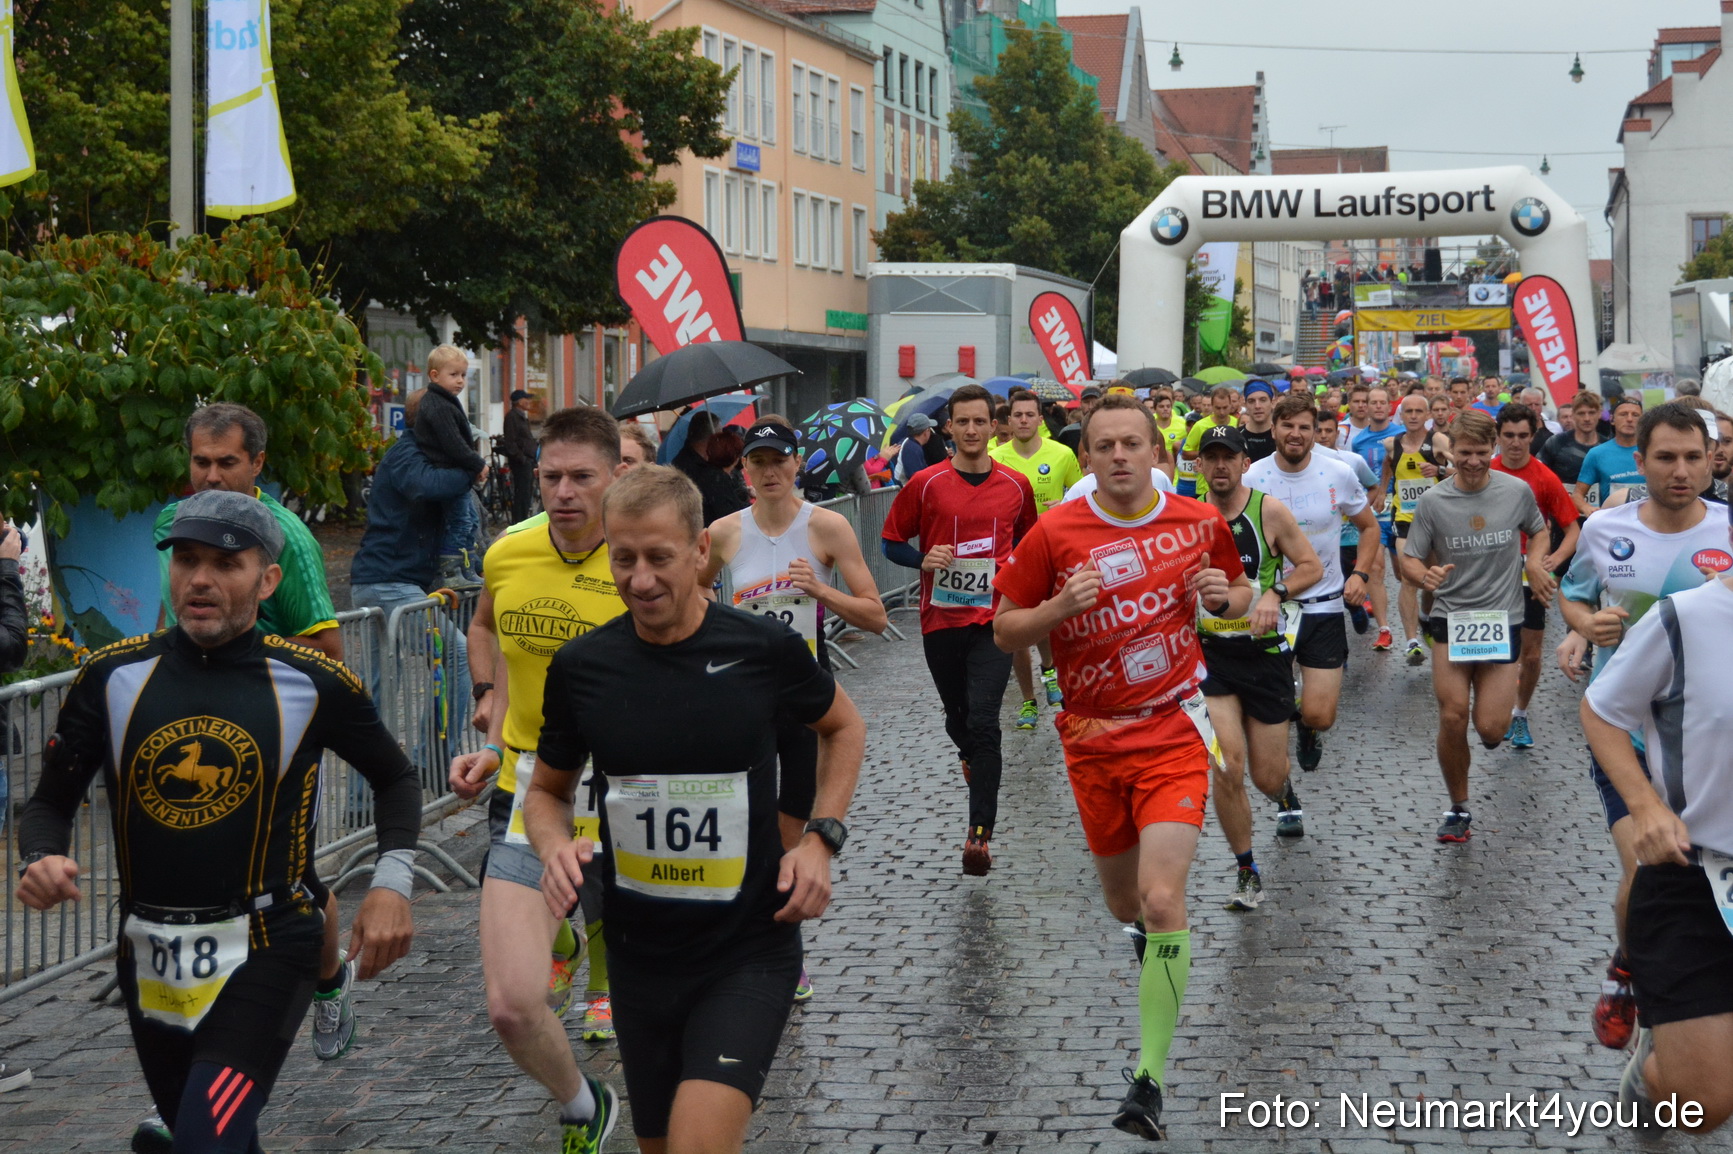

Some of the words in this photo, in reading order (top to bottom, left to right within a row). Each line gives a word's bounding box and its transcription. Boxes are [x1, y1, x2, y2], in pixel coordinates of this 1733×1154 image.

[1202, 188, 1304, 219] BMW
[1314, 184, 1496, 221] Laufsport
[1416, 314, 1450, 327] ZIEL
[1522, 288, 1573, 383] REWE
[393, 411, 403, 426] P
[1445, 529, 1513, 550] LEHMEIER
[1094, 540, 1134, 560] raumbox
[1697, 553, 1729, 567] Hervis
[1152, 552, 1198, 573] schenken
[1608, 564, 1635, 573] PARTL
[938, 568, 989, 593] 2624
[947, 593, 975, 604] Florian
[521, 599, 577, 621] PIZZERIA
[507, 614, 588, 639] FRANCESCO
[1455, 623, 1504, 643] 2228
[1096, 628, 1137, 646] wohnen
[1121, 637, 1161, 655] raumbox
[1461, 646, 1498, 655] Christoph
[140, 718, 256, 764] CONTINENTAL
[668, 779, 735, 795] BOCK
[139, 778, 250, 823] CONTINENTAL
[636, 807, 722, 852] 164
[651, 863, 705, 882] Albert
